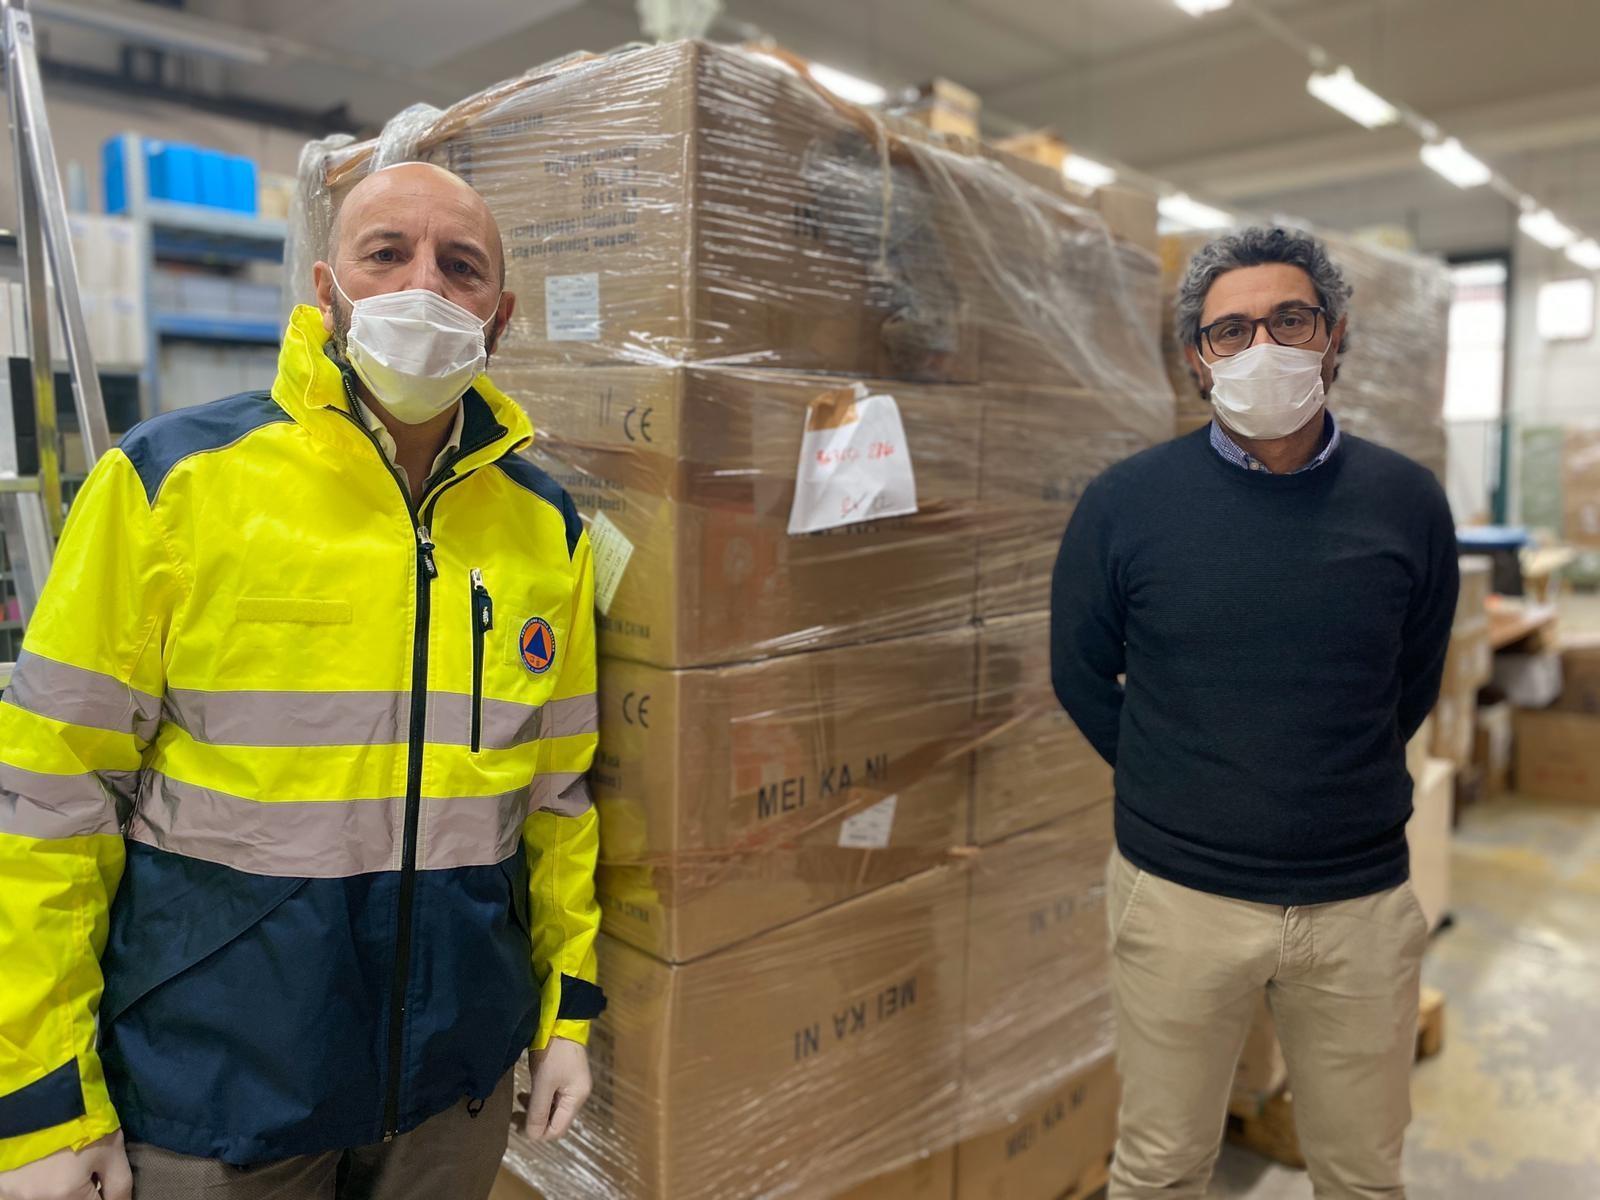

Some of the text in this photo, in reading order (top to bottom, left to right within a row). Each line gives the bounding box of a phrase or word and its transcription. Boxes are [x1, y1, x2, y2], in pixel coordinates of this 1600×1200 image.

[623, 405, 653, 443] CE
[622, 691, 651, 729] CE
[757, 754, 889, 820] MEI KA NI
[794, 976, 918, 1061] MEI KA NI
